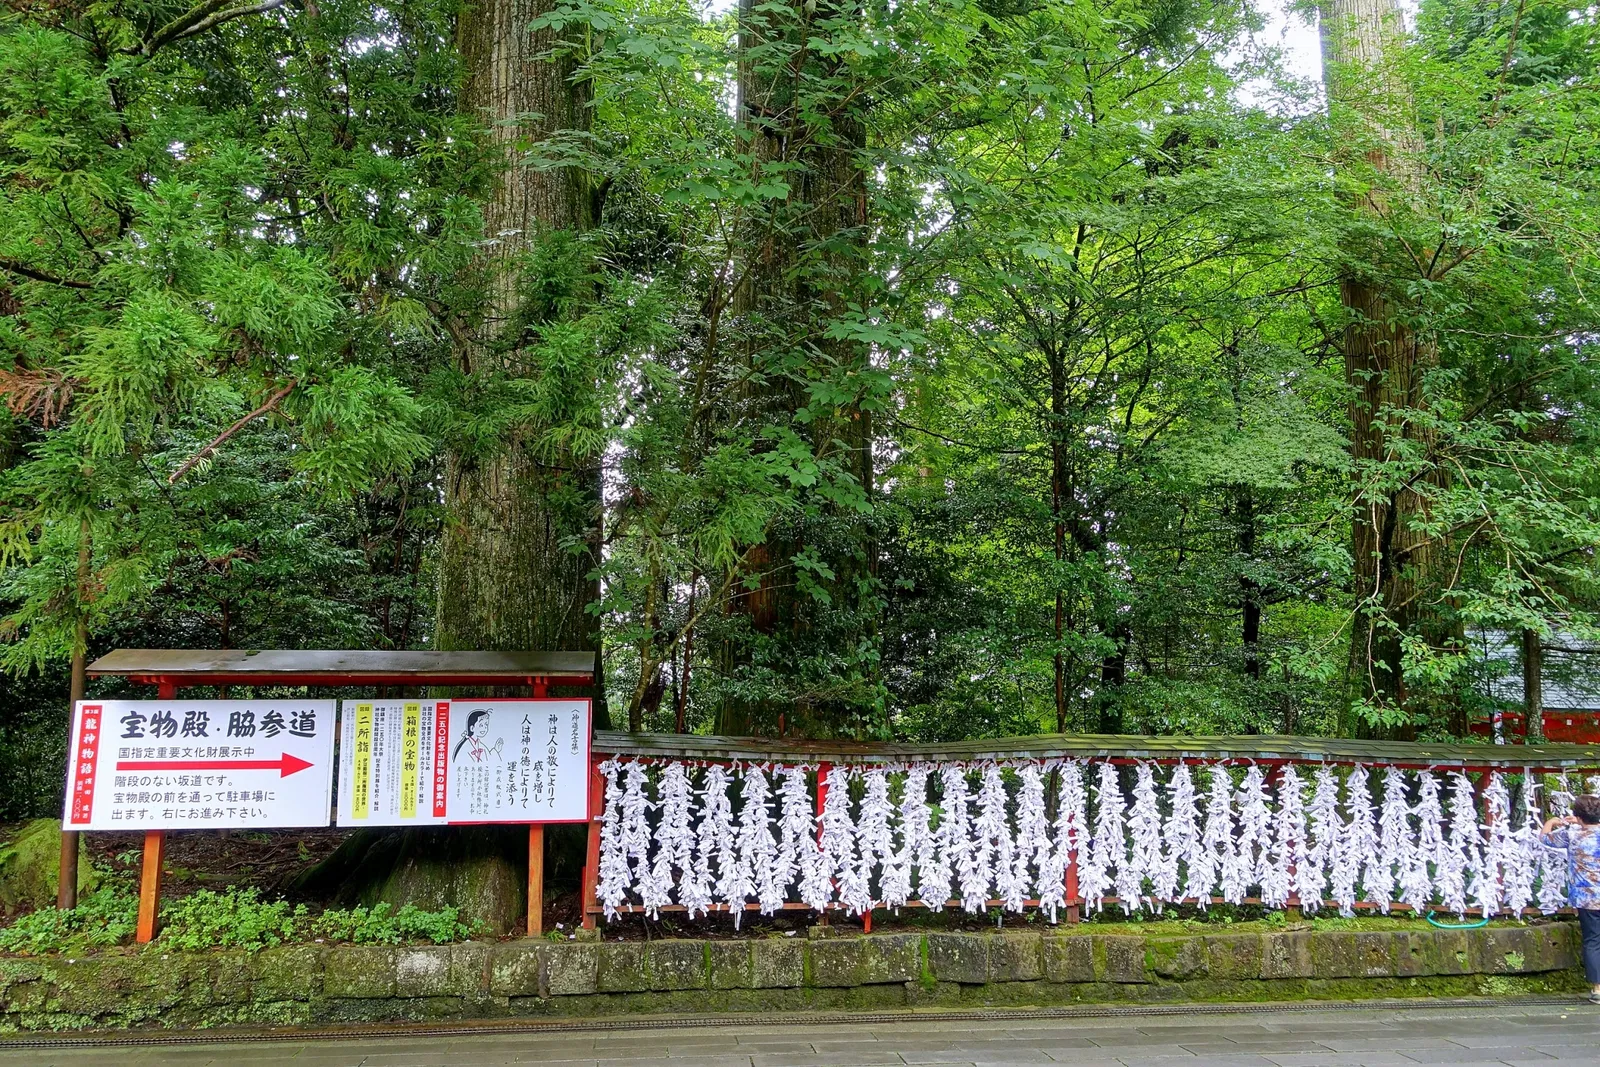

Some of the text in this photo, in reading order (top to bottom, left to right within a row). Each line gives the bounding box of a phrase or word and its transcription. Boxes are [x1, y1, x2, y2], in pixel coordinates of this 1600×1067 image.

[119, 709, 317, 739] 宝物殿・脇参道
[357, 715, 370, 753] 二所詣
[404, 715, 417, 771] 箱根の宝物
[80, 718, 98, 775] 龍神物語
[118, 746, 255, 759] 国指定重要文化財展示中
[436, 706, 447, 808] 一二五〇記念出版物の御案内
[520, 713, 532, 809] 人は神の徳によりて
[546, 713, 559, 808] 神は人の敬によりて
[113, 790, 276, 804] 宝物殿の前を通って駐車場に
[114, 774, 234, 787] 階段のない坂道です。
[505, 761, 518, 806] 運を添う
[532, 760, 544, 803] 威を増し
[111, 807, 269, 820] 出ます。右にお進み下さい。
